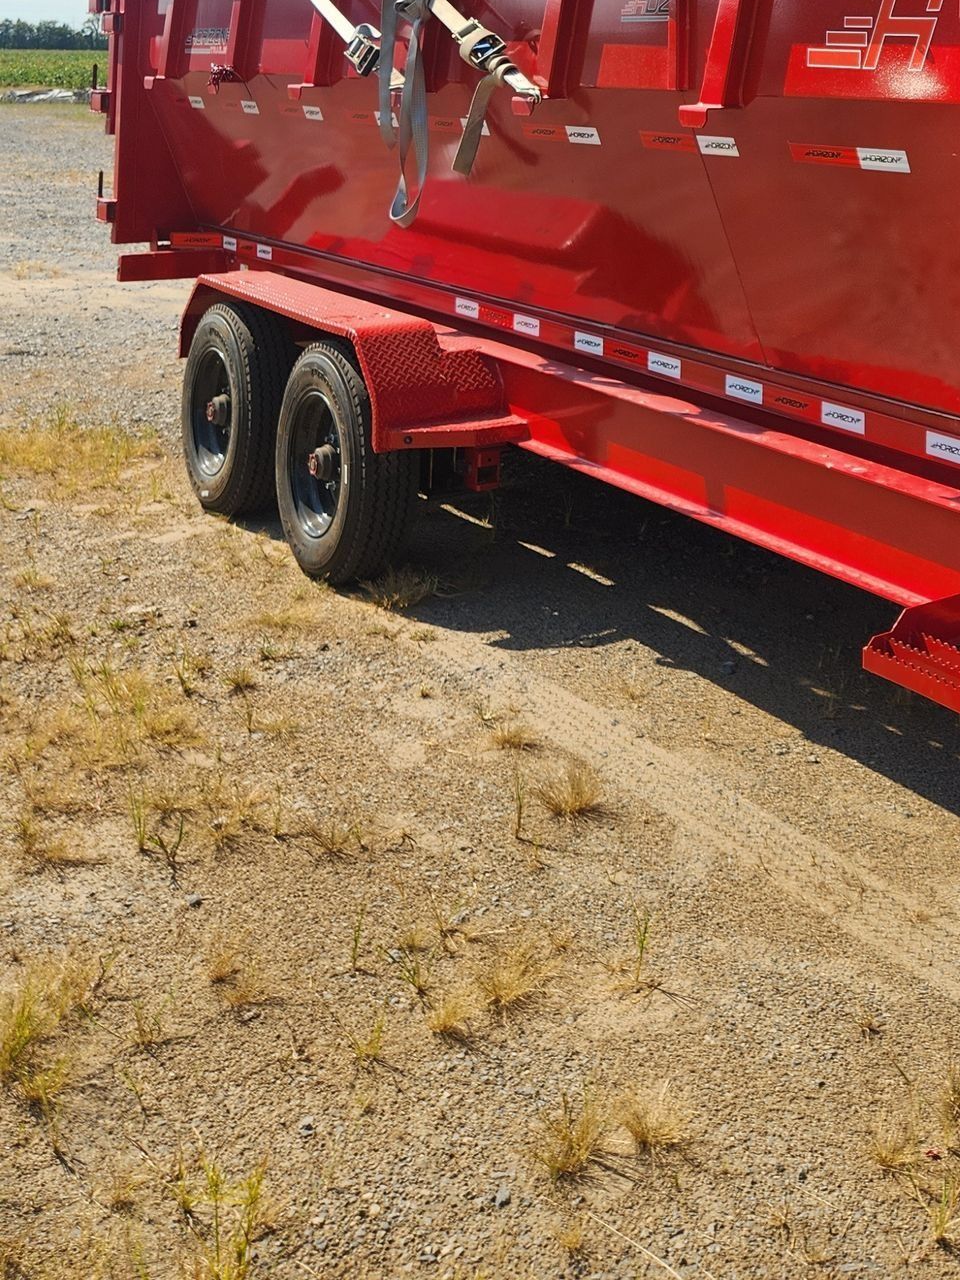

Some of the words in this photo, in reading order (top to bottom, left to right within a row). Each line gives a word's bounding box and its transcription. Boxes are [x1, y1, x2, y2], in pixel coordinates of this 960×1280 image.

[805, 149, 842, 158] HORIZON
[863, 154, 901, 164] HORIZON
[729, 383, 759, 395] HORIZON
[776, 396, 808, 410] HORIZON
[826, 410, 861, 425] HORIZON
